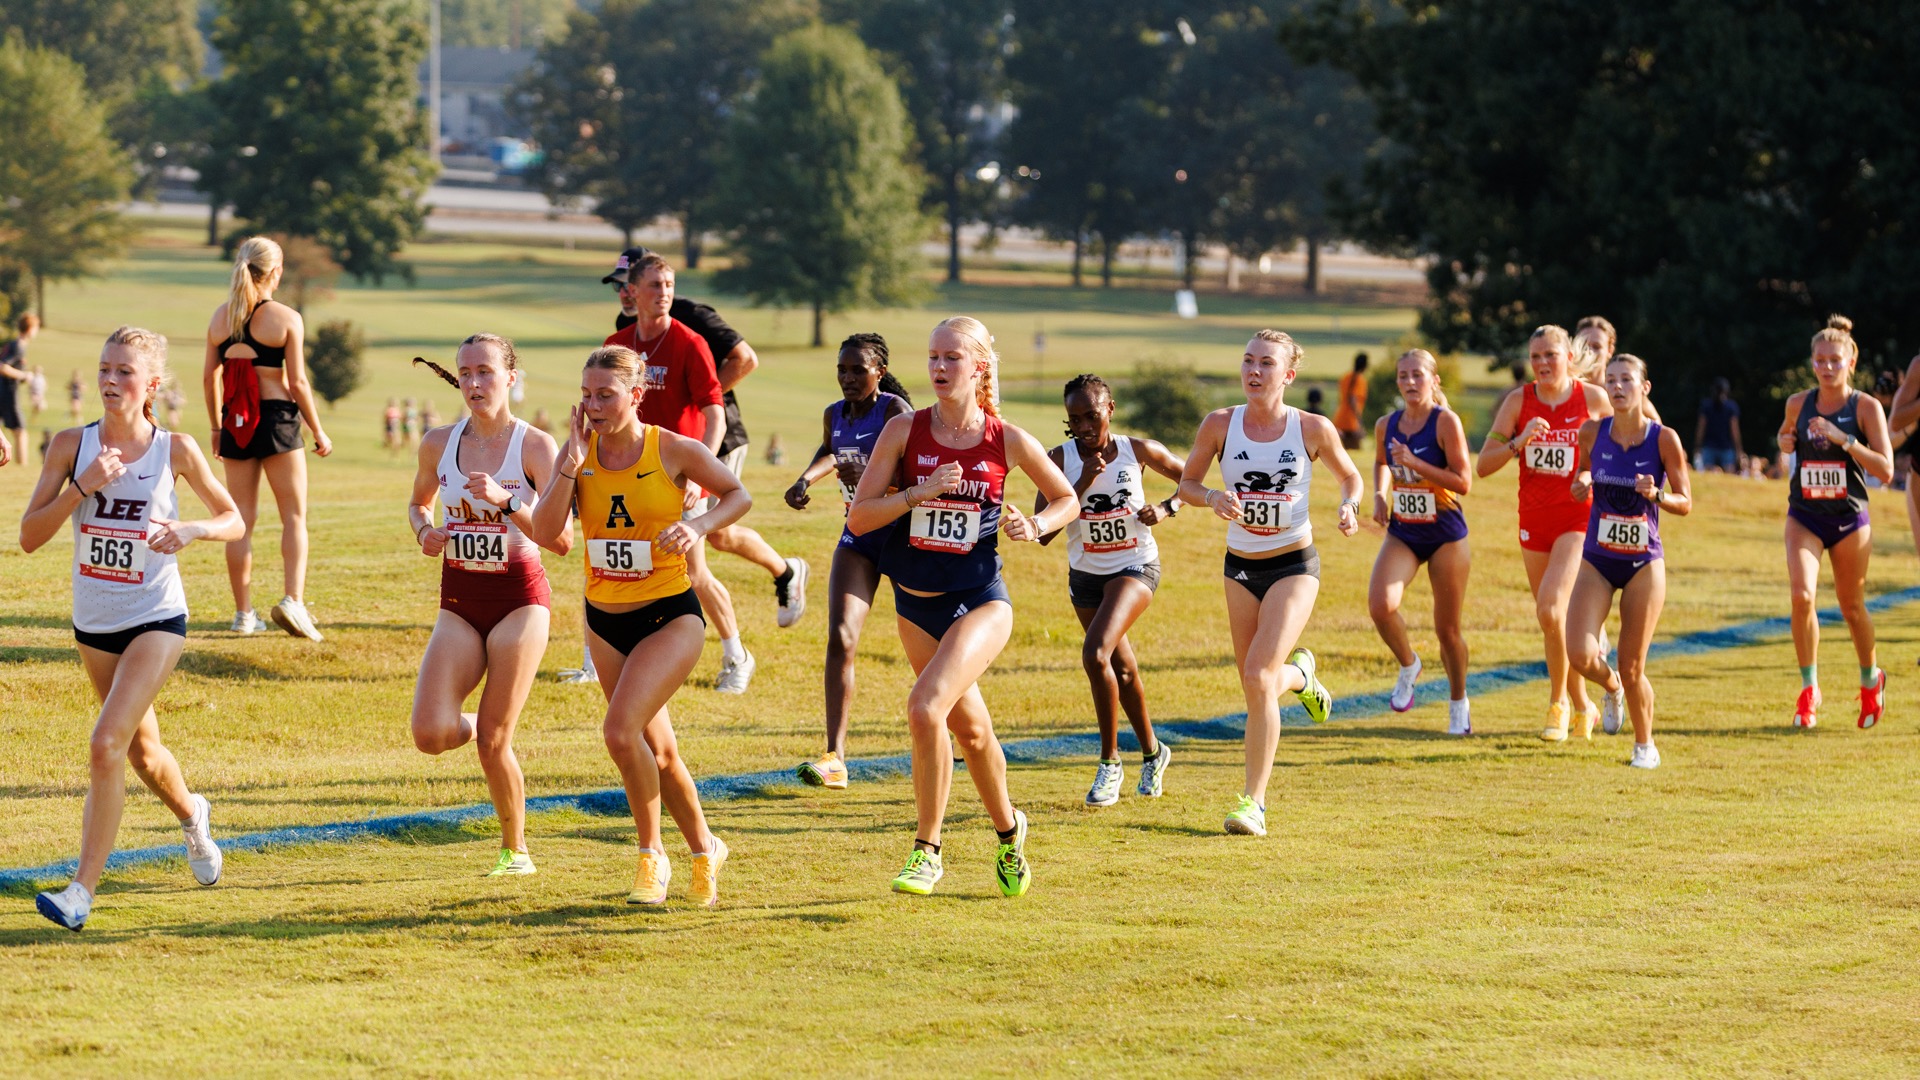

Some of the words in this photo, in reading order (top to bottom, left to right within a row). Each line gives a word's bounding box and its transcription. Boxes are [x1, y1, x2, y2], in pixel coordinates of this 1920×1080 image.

[918, 454, 939, 466] VALLEY
[1534, 447, 1565, 468] 248
[1807, 470, 1840, 486] 1190
[94, 491, 148, 521] LEE
[606, 494, 635, 528] A
[921, 501, 947, 509] SOUTHERN
[947, 503, 975, 511] SHOWCASE
[1244, 502, 1280, 528] 531
[1399, 494, 1427, 513] 983
[87, 527, 113, 537] SOUTHERN
[113, 530, 141, 539] SHOWCASE
[476, 525, 502, 533] SHOWCASE
[926, 510, 968, 540] 153
[1089, 519, 1127, 544] 536
[1607, 523, 1640, 545] 458
[90, 537, 133, 569] 563
[451, 533, 504, 561] 1034
[605, 541, 633, 569] 55
